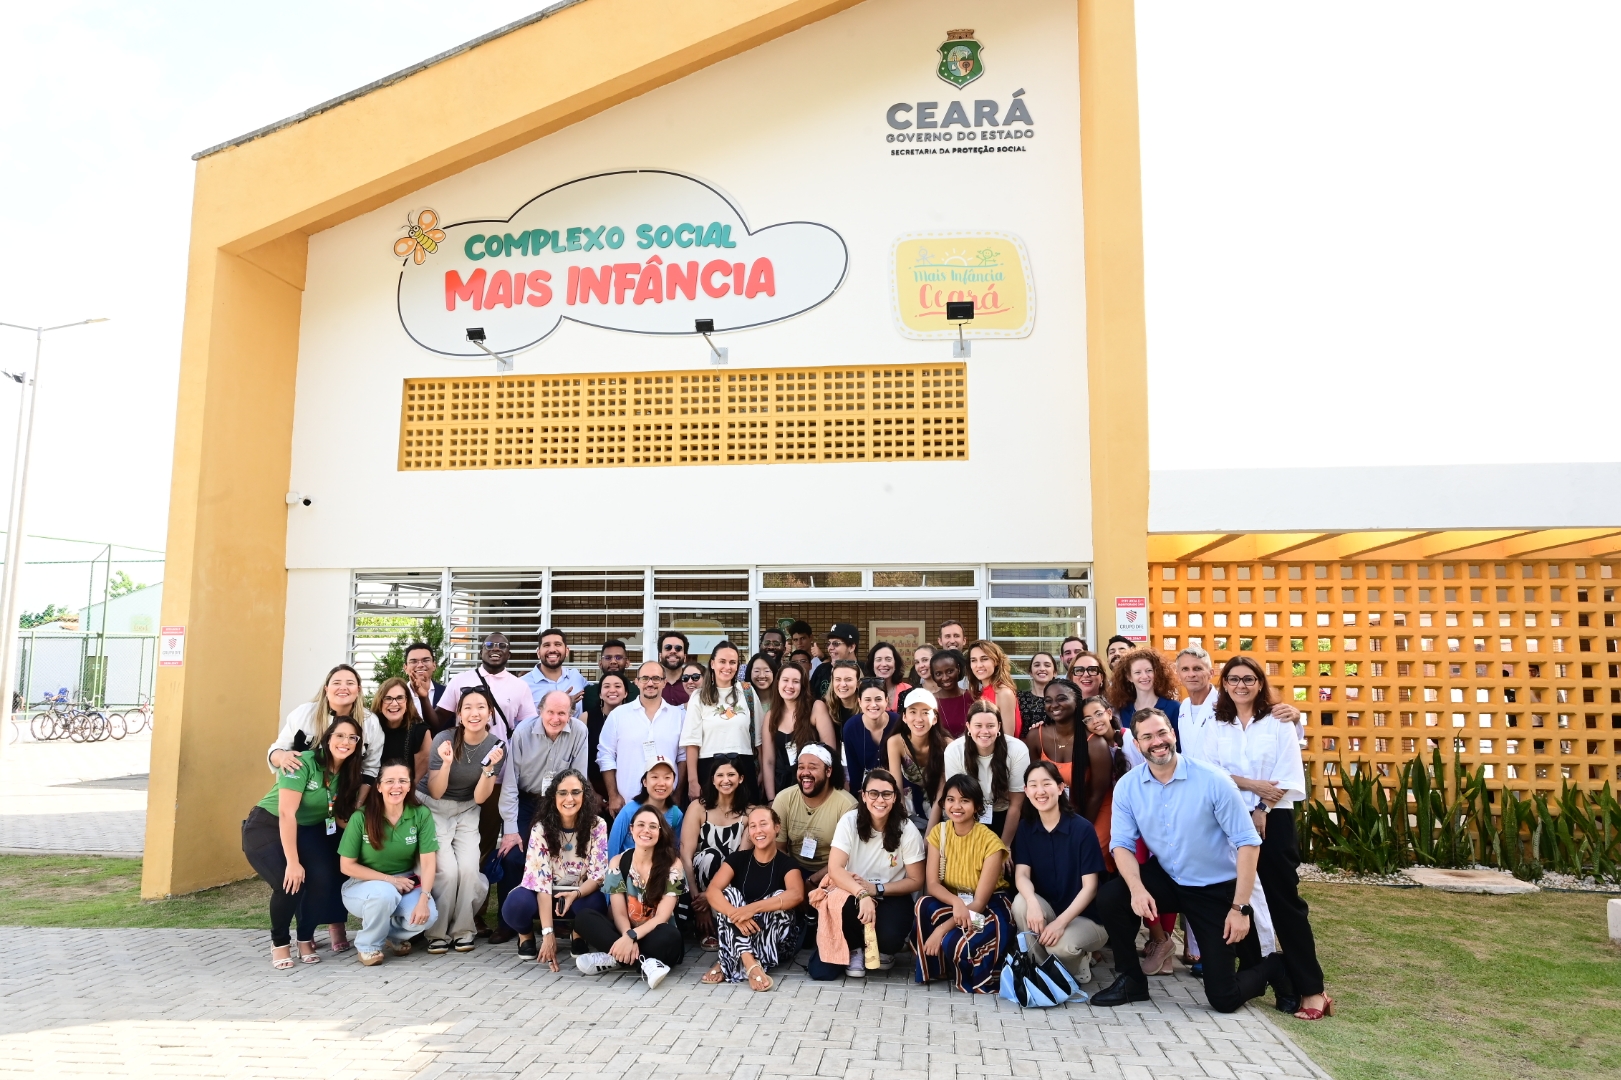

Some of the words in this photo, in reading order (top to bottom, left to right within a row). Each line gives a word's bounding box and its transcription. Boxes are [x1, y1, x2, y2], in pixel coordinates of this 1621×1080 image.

[886, 88, 1034, 130] CEARÁ
[886, 131, 953, 143] GOVERNO
[957, 130, 977, 141] DO
[981, 130, 1034, 140] ESTADO
[891, 148, 938, 156] SECRETARIA
[952, 145, 995, 155] PROTEÇÃO
[464, 225, 625, 261] COMPLEXO
[636, 221, 736, 249] SOCIAL
[445, 267, 553, 312] MAIS
[566, 254, 776, 306] INFÂNCIA
[913, 269, 946, 283] Mais
[951, 269, 1006, 285] Infância
